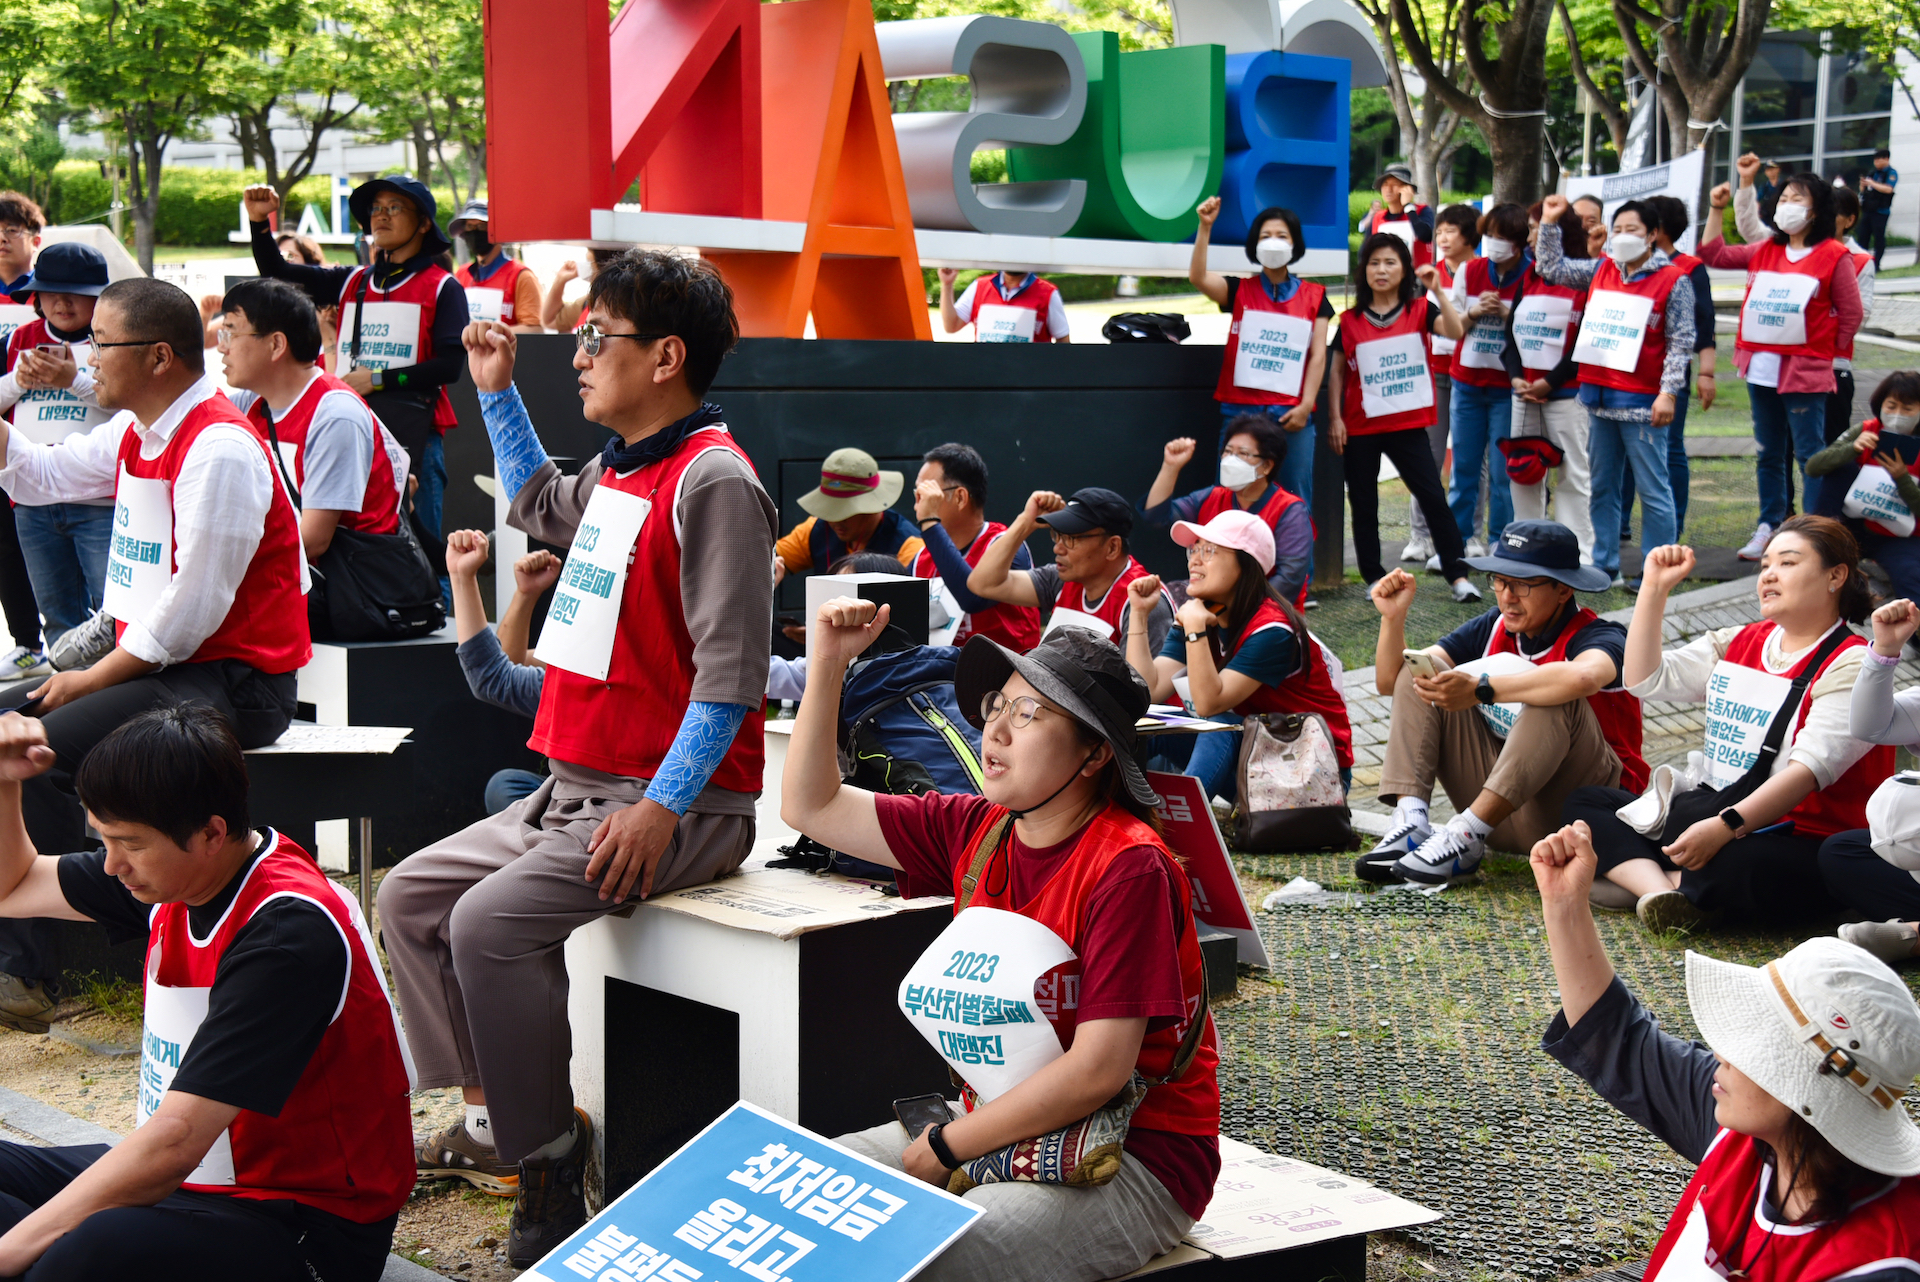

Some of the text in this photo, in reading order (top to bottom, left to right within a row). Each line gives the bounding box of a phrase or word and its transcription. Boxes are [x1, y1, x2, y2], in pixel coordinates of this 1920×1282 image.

[1767, 288, 1790, 298] 2023
[1526, 312, 1547, 322] 2023
[1601, 308, 1626, 320] 2023
[360, 324, 390, 337] 2023
[993, 320, 1016, 332] 2023
[1584, 321, 1639, 340] 부산차별철폐
[1259, 330, 1288, 344] 2023
[1591, 336, 1620, 351] 대행진
[1240, 342, 1302, 362] 부산차별철폐
[1379, 352, 1408, 368] 2023
[1250, 358, 1284, 375] 대행진
[1364, 364, 1426, 386] 부산차별철폐
[1382, 380, 1414, 398] 대행진
[37, 405, 88, 422] 대행진
[575, 522, 600, 552] 2023
[1710, 673, 1730, 694] 모든
[1706, 694, 1772, 728] 노동자에게
[942, 950, 1000, 984] 2023
[904, 984, 1036, 1026] 부산차별철폐
[938, 1030, 1005, 1066] 대행진
[726, 1141, 908, 1242] 최저임금
[673, 1197, 818, 1282] 올리고
